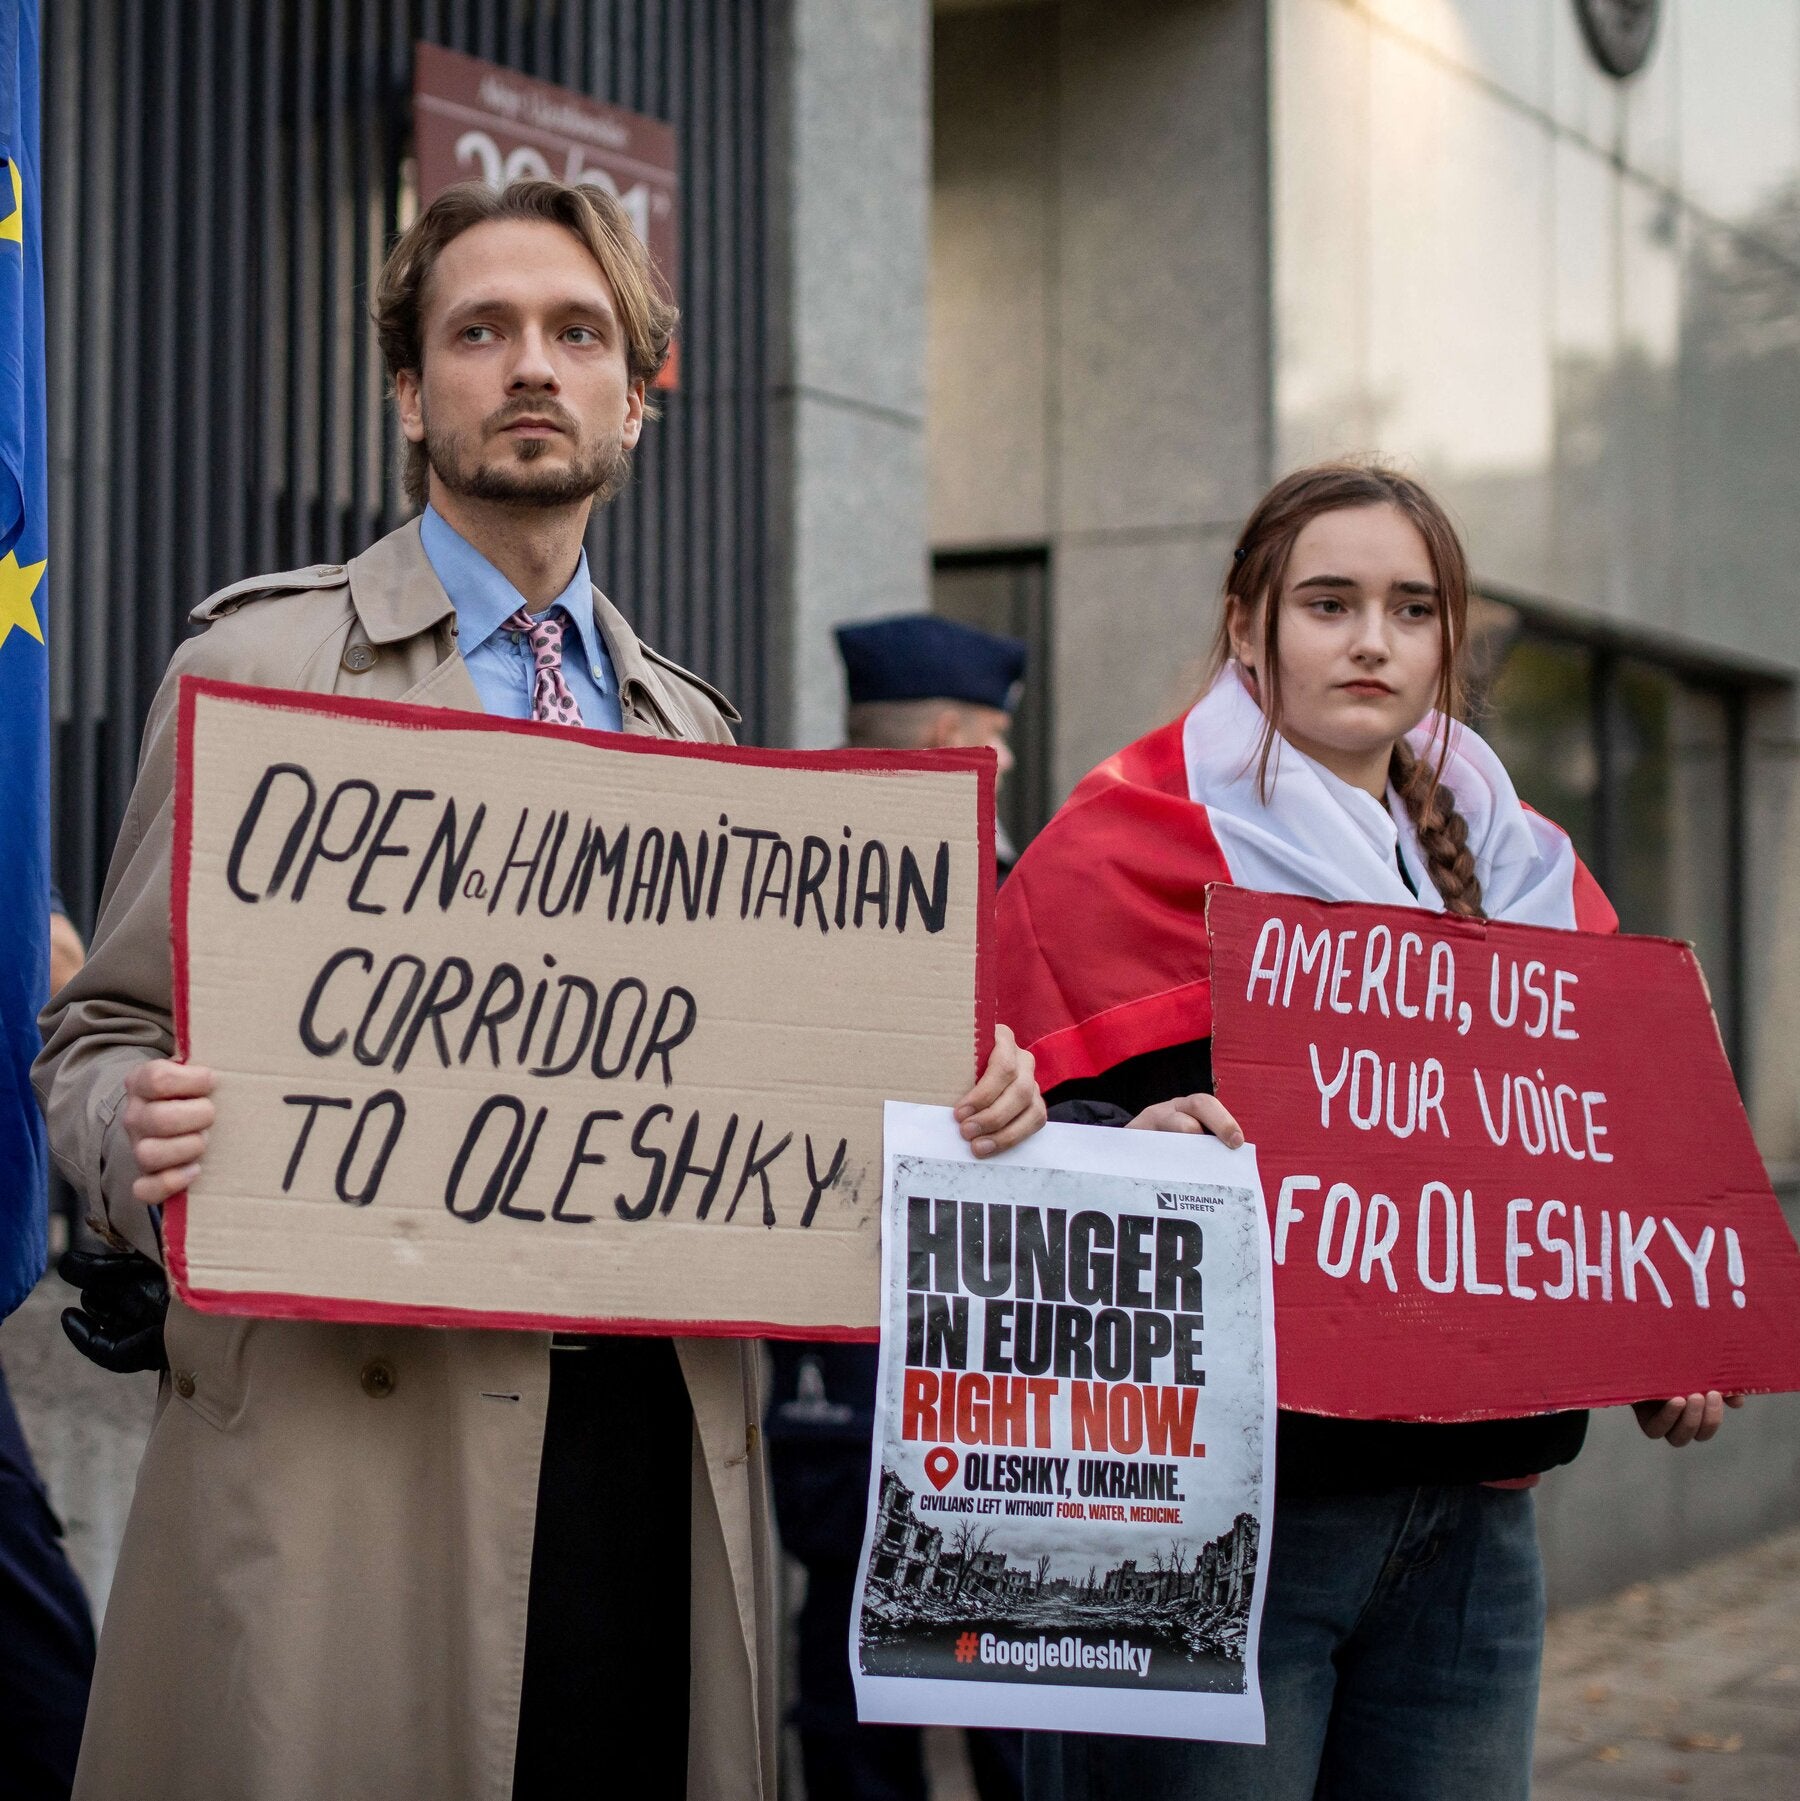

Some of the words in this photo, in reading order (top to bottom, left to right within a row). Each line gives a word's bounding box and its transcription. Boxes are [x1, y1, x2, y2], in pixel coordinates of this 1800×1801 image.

[226, 761, 487, 916] OPEN
[463, 867, 489, 901] a
[1246, 917, 1474, 1036] AMERCA,
[1490, 952, 1580, 1040] USE
[1309, 1042, 1450, 1139] YOUR
[282, 1087, 407, 1206] TO
[444, 1093, 850, 1230] OLESHKY
[1178, 1194, 1224, 1205] UKRAINIAN
[907, 1195, 1204, 1312] HUNGER
[1180, 1202, 1215, 1212] STREETS
[1274, 1174, 1399, 1294] FOR
[1416, 1180, 1747, 1310] OLESHKY!
[906, 1292, 969, 1371] IN
[983, 1299, 1206, 1387] EUROPE
[902, 1369, 1059, 1450] RIGHT
[1071, 1379, 1206, 1458] NOW.
[920, 1494, 974, 1513] CIVILIANS
[976, 1497, 1002, 1515] LEFT
[1005, 1499, 1054, 1518] WITHOUT
[1056, 1502, 1086, 1521] FOOD,
[1088, 1503, 1128, 1523] WATER,
[1129, 1506, 1184, 1525] MEDICINE.
[963, 1452, 1072, 1500] OLESHKY,
[1077, 1458, 1186, 1502] UKRAINE.
[954, 1630, 1153, 1678] #GoogleOleshky
